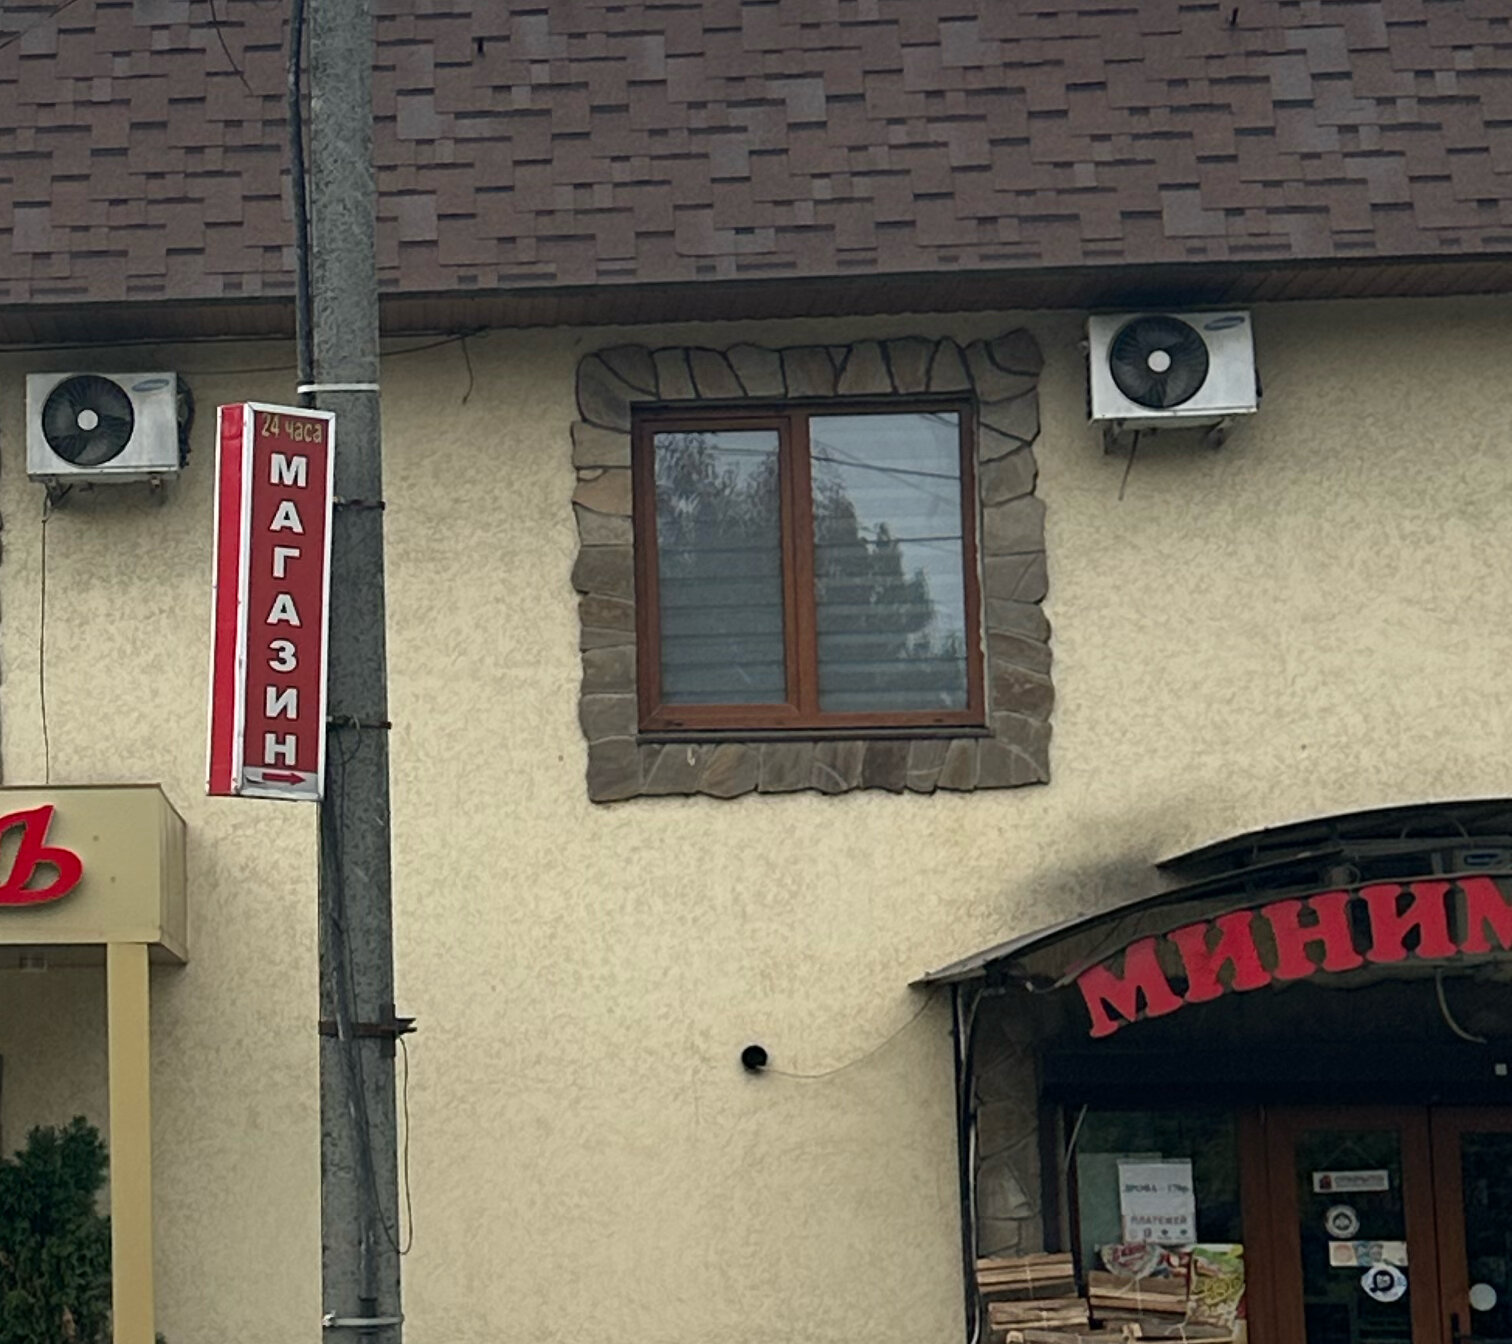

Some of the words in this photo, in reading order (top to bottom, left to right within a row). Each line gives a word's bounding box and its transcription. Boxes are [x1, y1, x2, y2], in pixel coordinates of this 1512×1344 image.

[261, 413, 280, 438] 24
[285, 420, 322, 444] часа
[263, 452, 307, 766] МАГАЗИН
[1130, 1215, 1187, 1225] ПЛАТЕЖЕЙ
